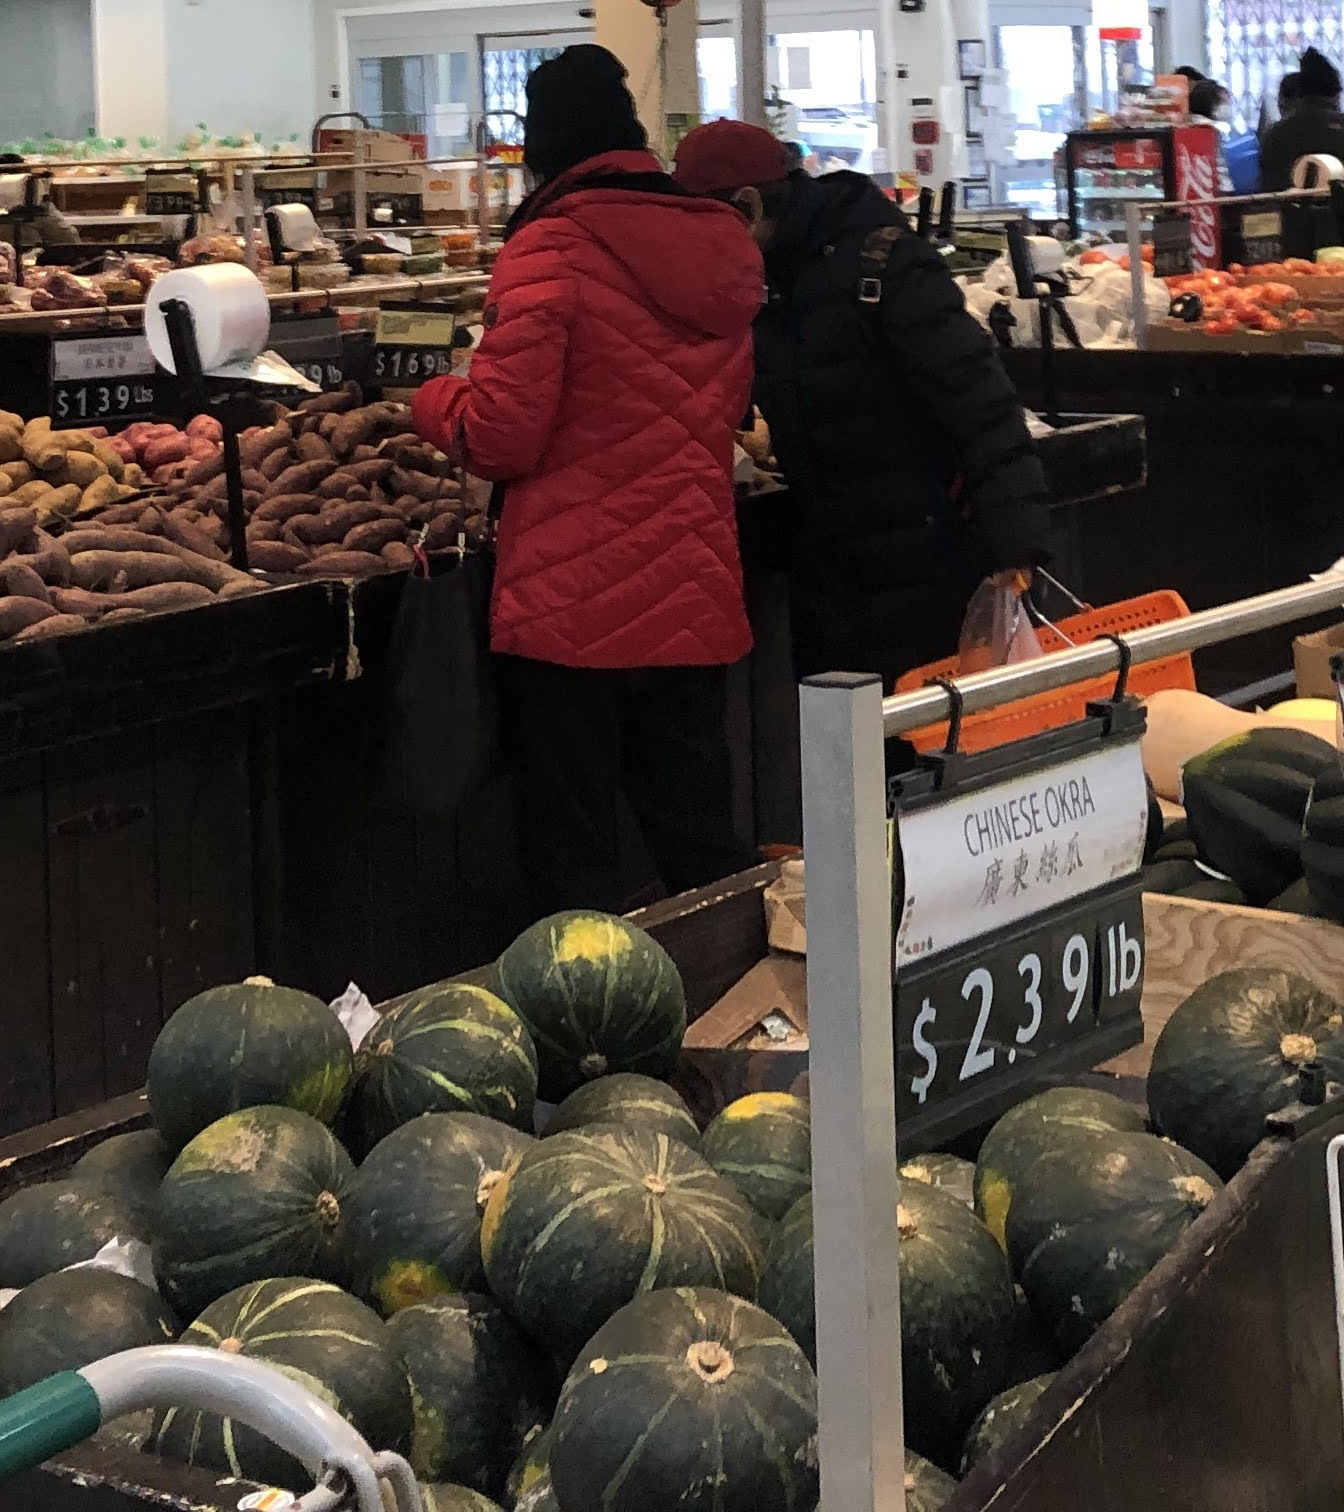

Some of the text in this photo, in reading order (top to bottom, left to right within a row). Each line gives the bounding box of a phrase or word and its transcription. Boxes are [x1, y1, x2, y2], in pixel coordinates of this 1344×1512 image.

[963, 792, 1044, 857] CHINESE
[1044, 775, 1096, 828] OKRA
[911, 921, 1142, 1104] $2.39 lb
